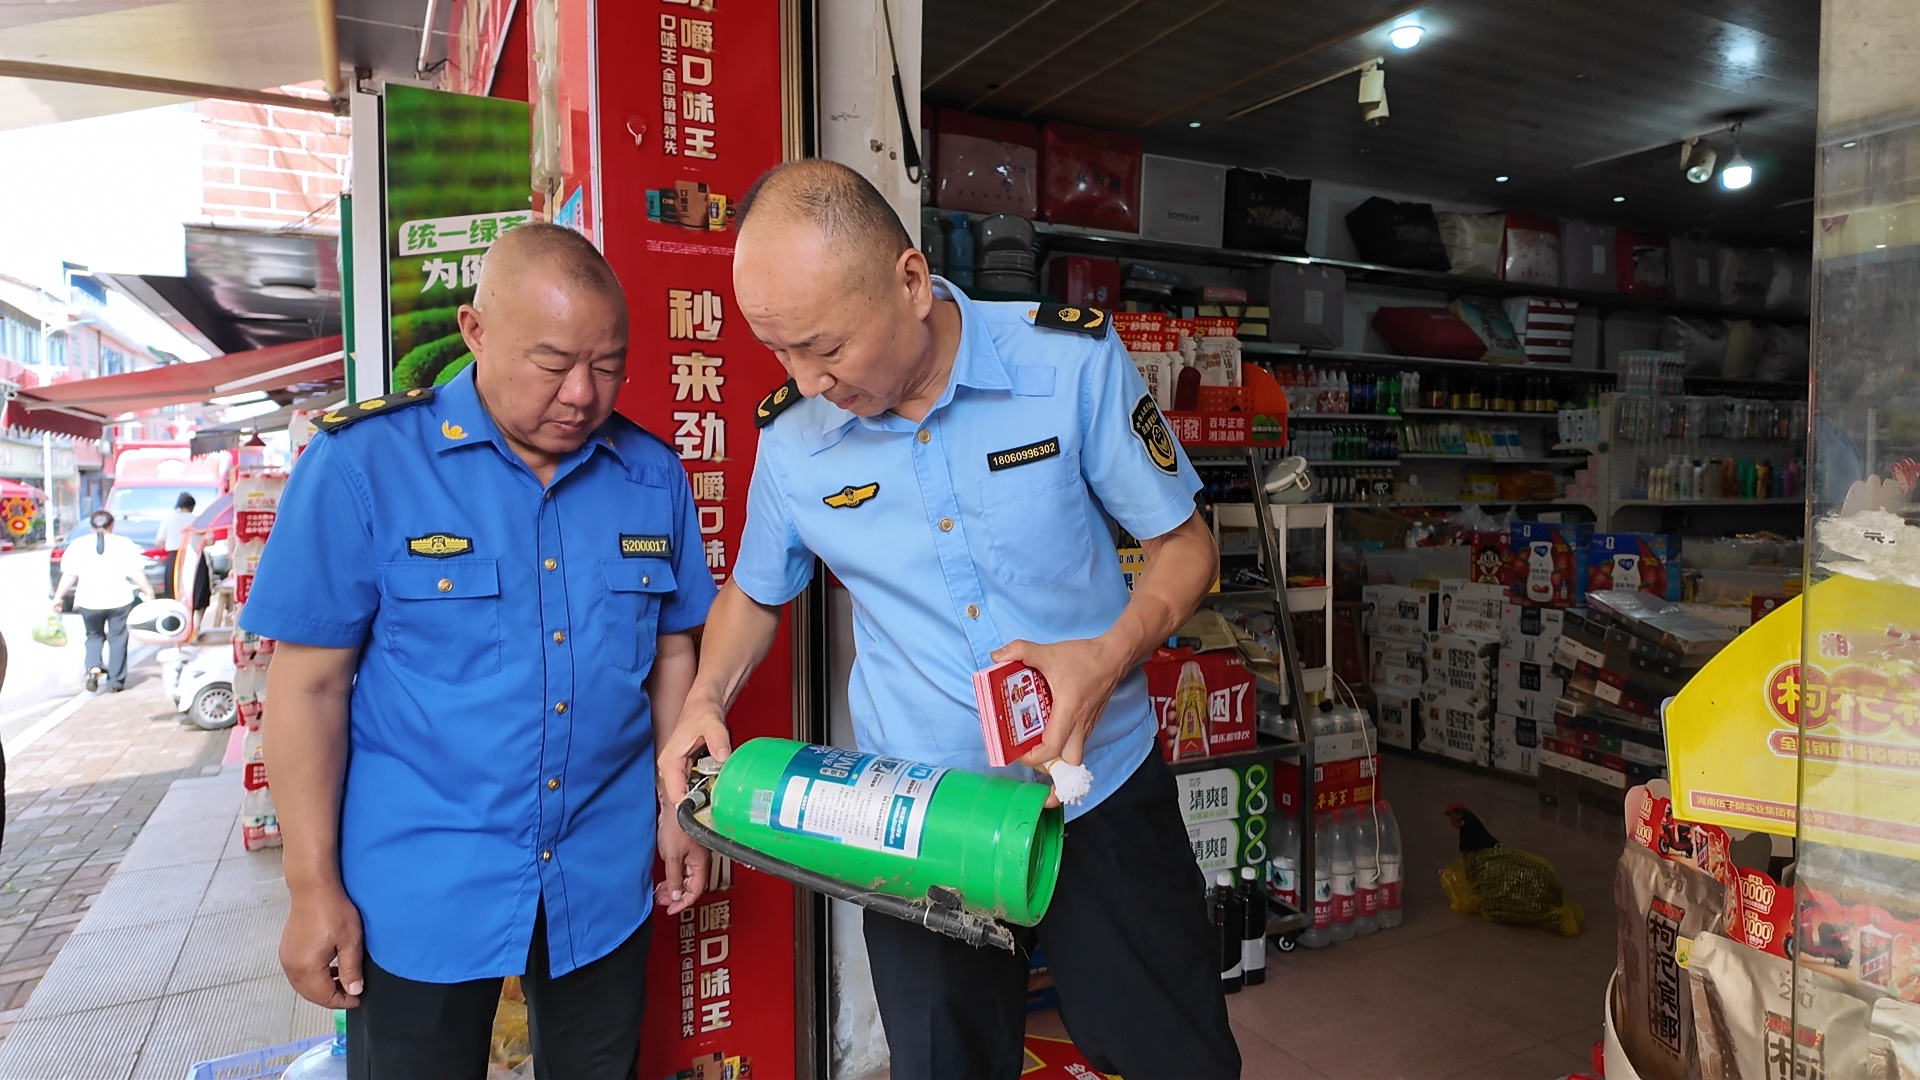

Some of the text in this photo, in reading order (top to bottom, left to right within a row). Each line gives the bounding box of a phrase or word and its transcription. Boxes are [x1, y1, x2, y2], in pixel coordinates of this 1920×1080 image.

[660, 13, 677, 65] 口味王
[681, 18, 717, 160] 嚼口味王
[669, 289, 725, 461] 秒来劲
[1208, 430, 1245, 442] 湘潭品牌
[1209, 417, 1245, 427] 百年正宗
[992, 442, 1057, 467] 18060996302
[622, 539, 667, 552] 52000017
[1208, 681, 1250, 723] 困了
[1189, 786, 1220, 811] 清爽
[1696, 795, 1825, 825] 湖南伍子醉实业集团有公司
[700, 899, 733, 1033] 嚼口味王
